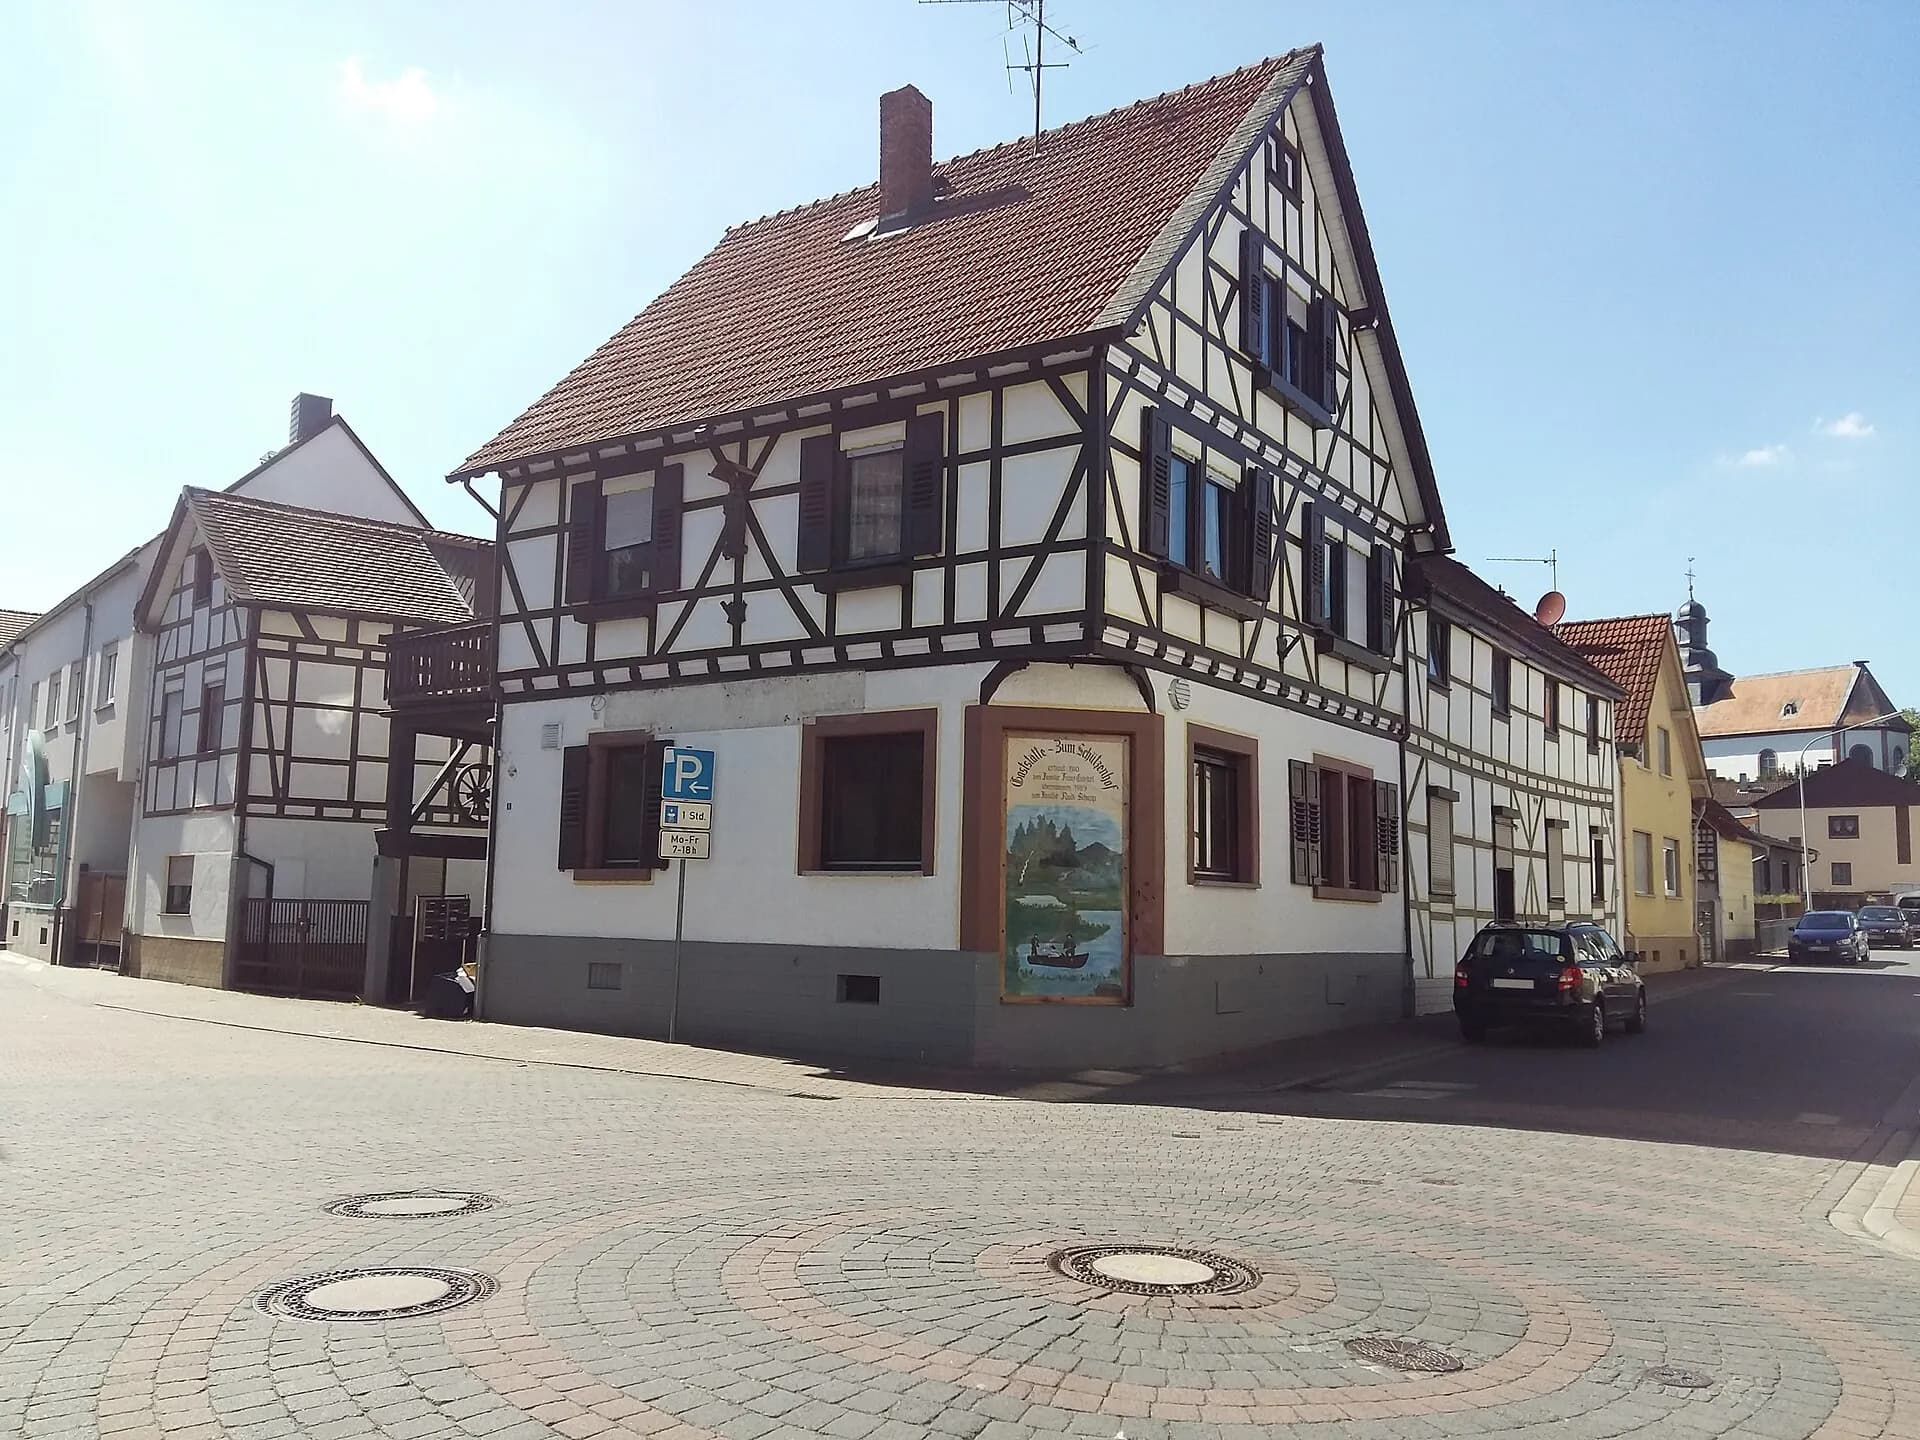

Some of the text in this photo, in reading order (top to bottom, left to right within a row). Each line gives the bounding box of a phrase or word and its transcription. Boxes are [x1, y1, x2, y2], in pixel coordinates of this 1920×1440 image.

[674, 755, 703, 793] P
[682, 811, 706, 821] 1 Std.
[670, 835, 699, 845] Mo-Fr
